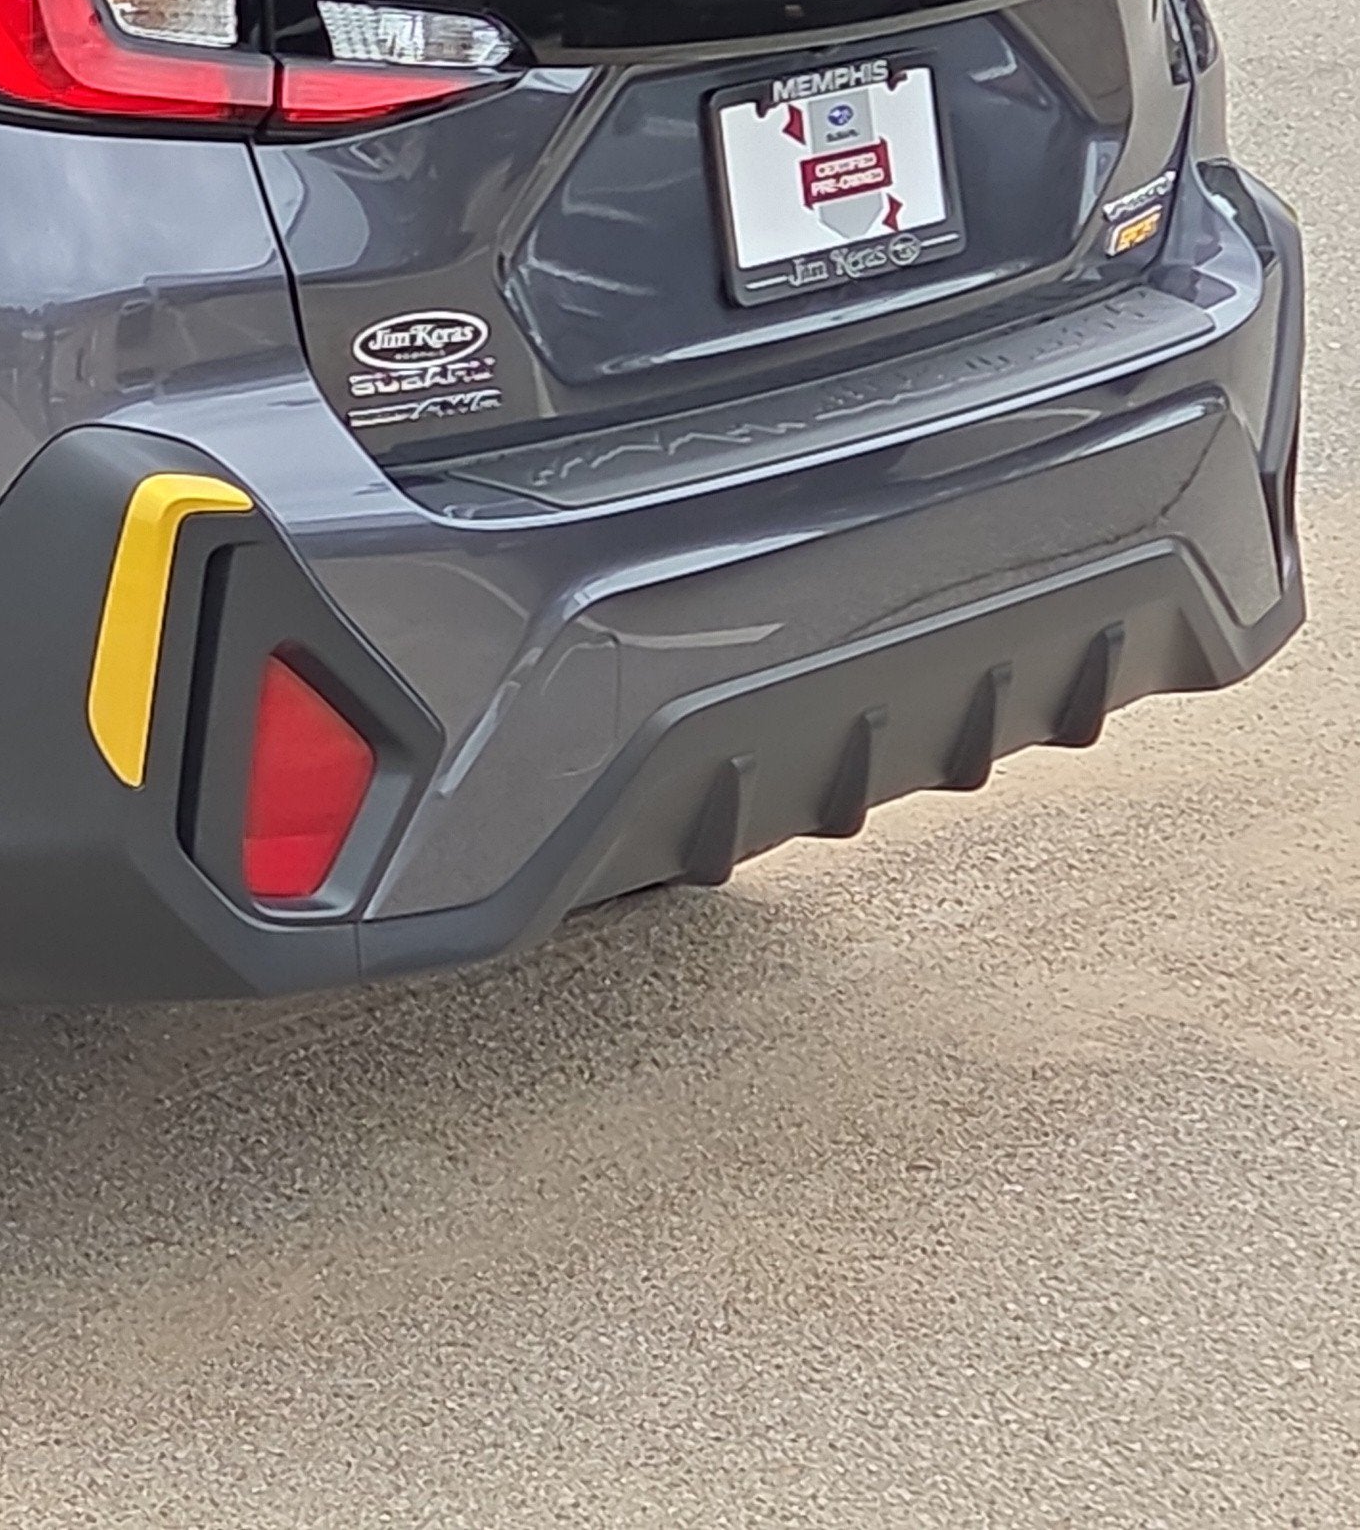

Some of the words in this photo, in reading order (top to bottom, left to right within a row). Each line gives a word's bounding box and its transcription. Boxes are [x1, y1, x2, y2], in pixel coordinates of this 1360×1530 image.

[773, 59, 889, 102] MEMPHIS
[788, 257, 829, 286] Jim
[368, 328, 411, 351] Jim
[409, 324, 475, 348] Keras
